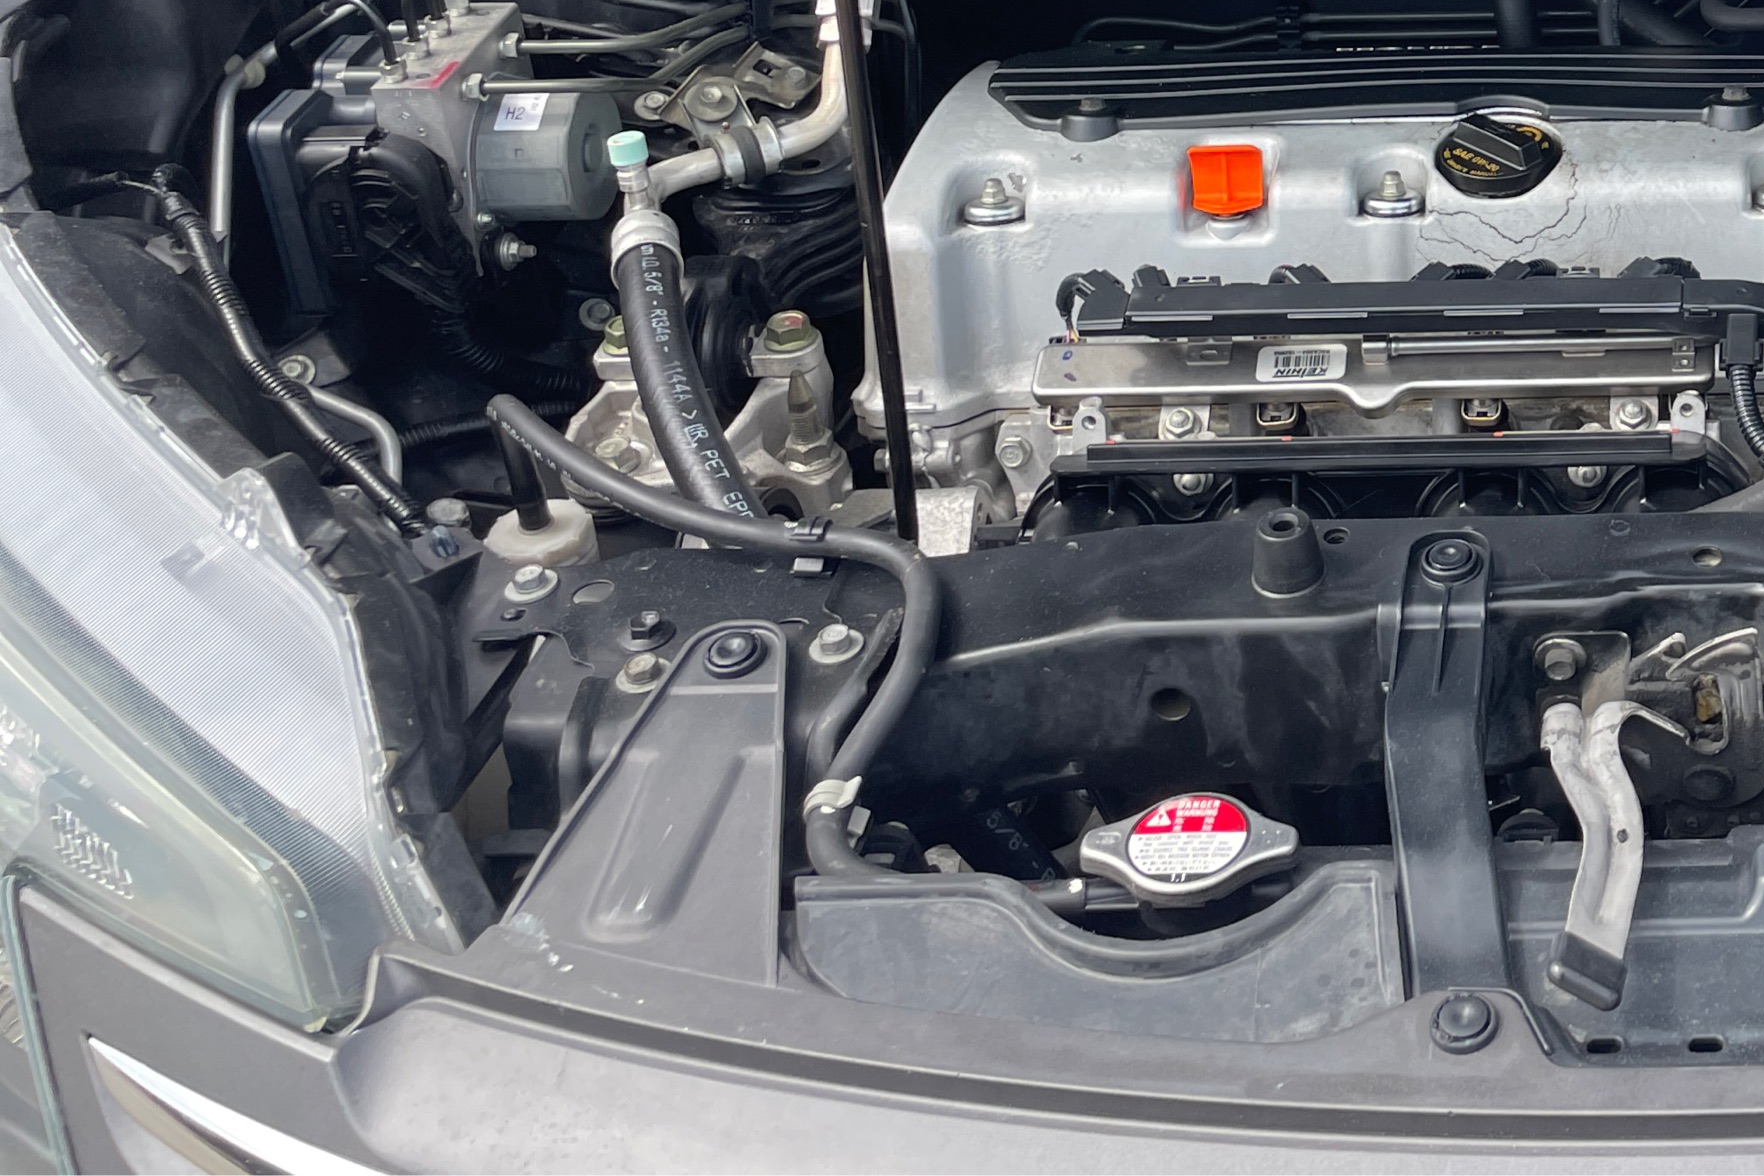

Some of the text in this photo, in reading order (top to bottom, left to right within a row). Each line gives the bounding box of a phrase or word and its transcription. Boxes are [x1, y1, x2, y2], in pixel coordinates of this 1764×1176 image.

[505, 106, 526, 121] H2
[1452, 147, 1475, 161] SAE
[650, 308, 672, 343] R134a
[700, 449, 731, 480] PET
[1178, 799, 1222, 809] DANGER
